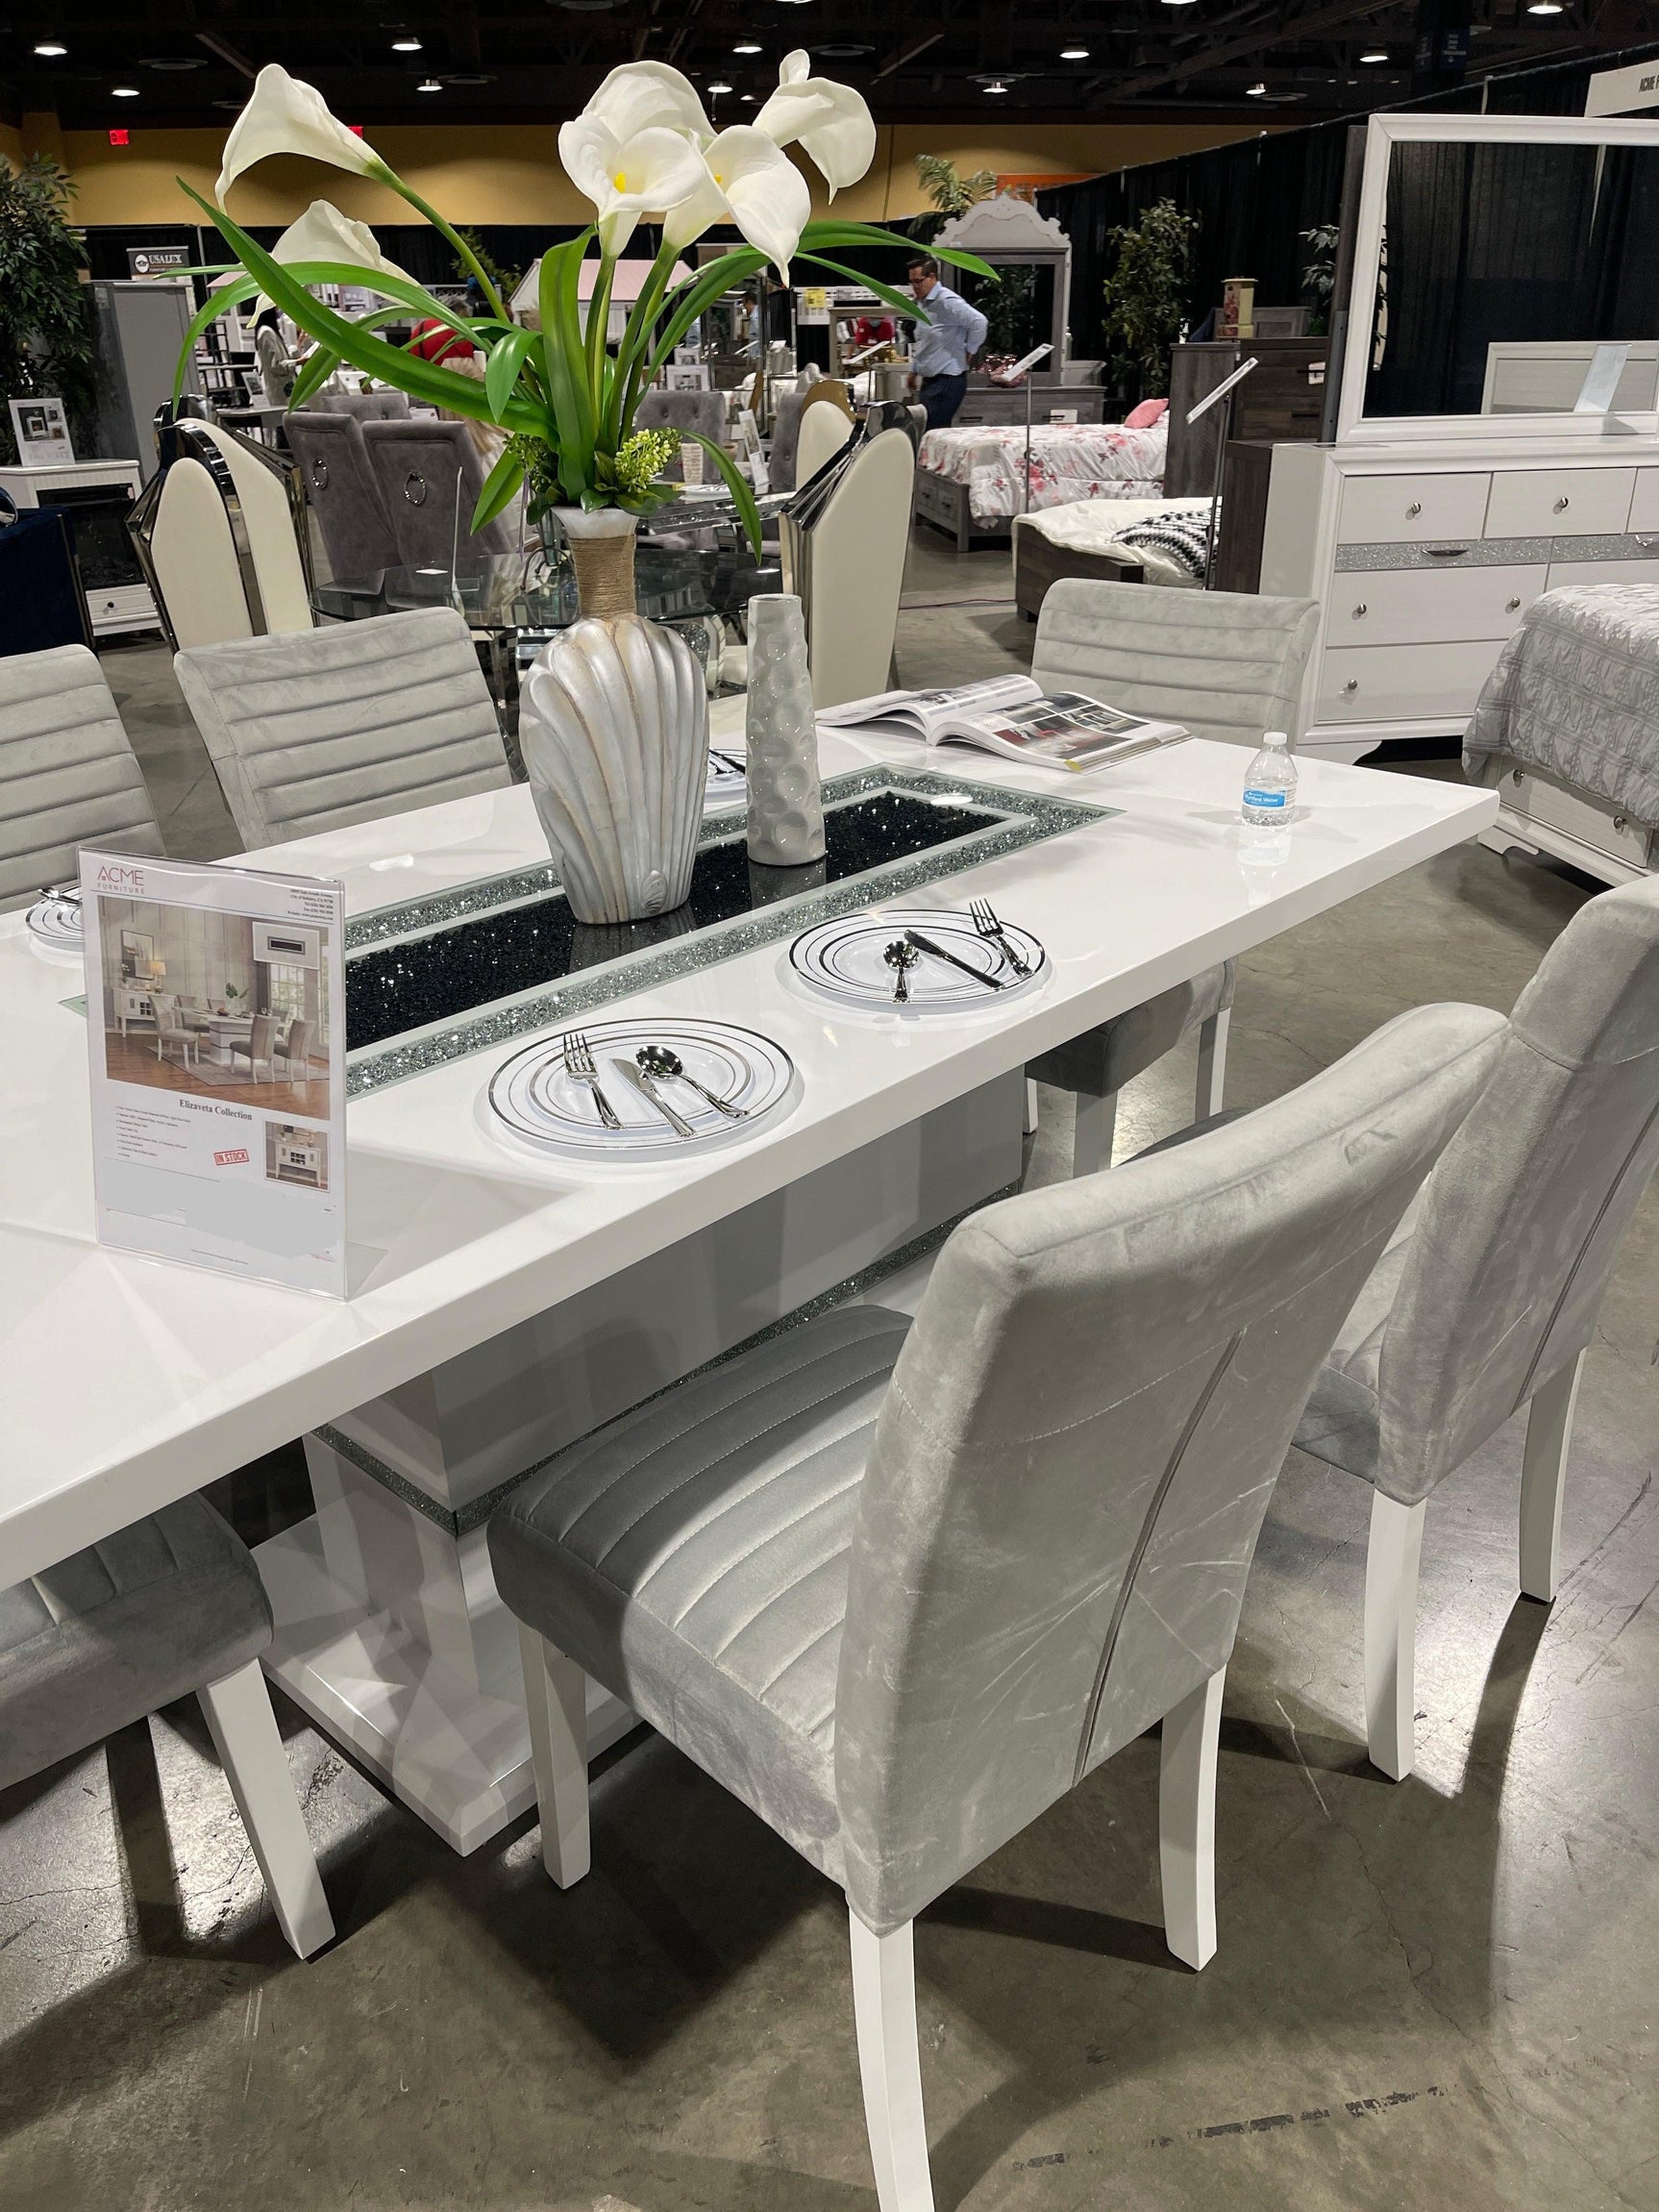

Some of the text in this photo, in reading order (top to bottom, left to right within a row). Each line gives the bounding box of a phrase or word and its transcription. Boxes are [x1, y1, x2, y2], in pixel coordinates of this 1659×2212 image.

[97, 866, 144, 885] ACME
[97, 882, 145, 894] FURNITURE
[180, 1099, 253, 1120] Elizaveta Collection
[216, 1152, 247, 1163] IN STOCK
